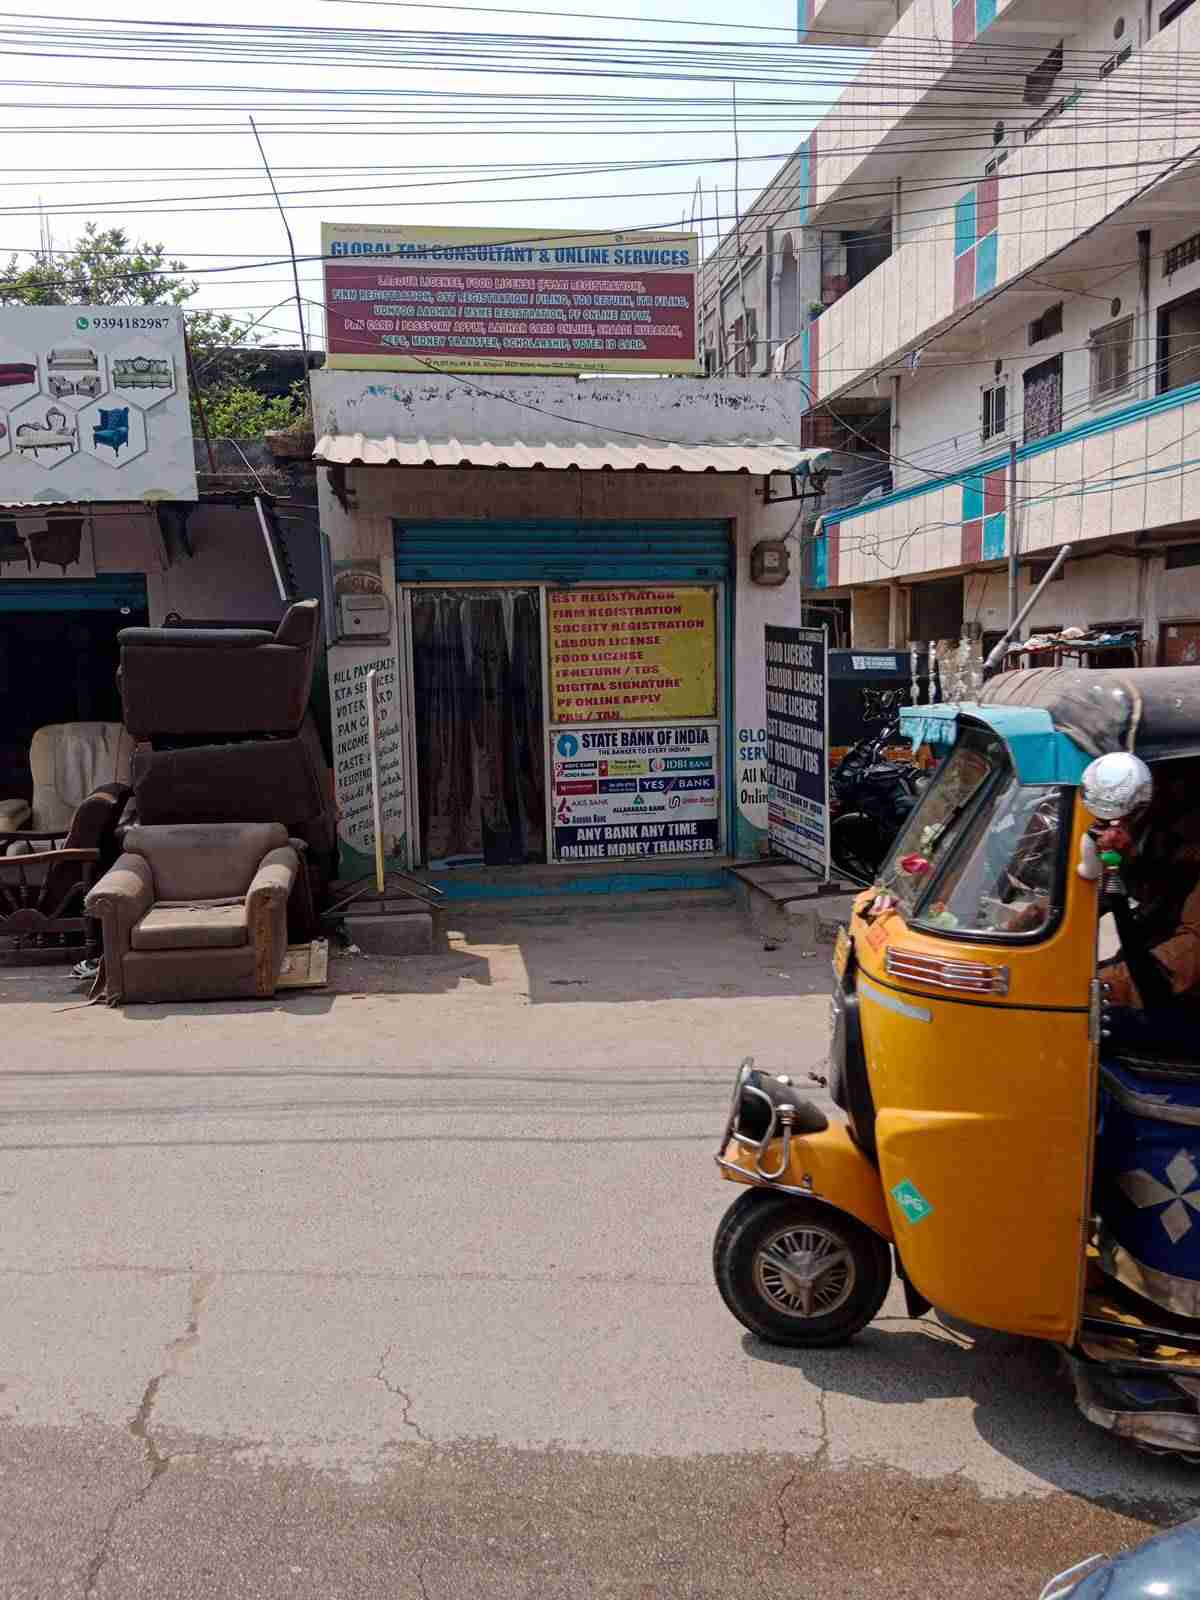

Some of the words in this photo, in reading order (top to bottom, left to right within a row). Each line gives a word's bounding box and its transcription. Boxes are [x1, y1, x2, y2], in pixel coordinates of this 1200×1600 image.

[331, 241, 393, 259] GLOBAL
[431, 245, 534, 263] CONSULTANT
[539, 249, 552, 264] &
[555, 248, 610, 265] ONLINE
[614, 249, 689, 266] SERVICES
[466, 278, 493, 289] FOOD
[495, 278, 536, 290] LICENSE
[458, 292, 529, 304] REGISTRATION
[583, 309, 618, 321] ONLINE
[93, 317, 170, 329] 9394182987
[367, 320, 394, 331] CARD
[529, 323, 555, 334] CARD
[412, 336, 447, 348] MONEY
[573, 339, 604, 350] VOTER
[580, 591, 675, 603] REGISTRATION
[553, 609, 586, 619] FIRM
[588, 605, 682, 618] REGISTRATION
[553, 623, 609, 634] SOCEITY
[611, 619, 705, 632] REGISTRATION
[554, 637, 606, 649] LABOUR
[608, 635, 662, 647] LICENSE
[555, 653, 589, 664] FOOD
[591, 651, 645, 662] LICENSE
[784, 643, 813, 668] LICENSE
[633, 665, 659, 676] TDS
[557, 682, 607, 693] DIGITAL
[608, 678, 683, 691] SIGNATURE
[793, 671, 824, 696] LICENSE
[575, 694, 621, 706] ONLINE
[623, 693, 663, 705] APPLY
[336, 700, 366, 718] VOTER
[788, 694, 818, 722] LICENSE
[336, 720, 358, 737] PAN
[779, 720, 824, 751] REGISTRATION
[581, 733, 619, 749] STATE
[621, 731, 655, 747] BANK
[657, 730, 674, 745] OF
[675, 728, 711, 744] INDIA
[638, 747, 647, 755] TO
[338, 753, 364, 774] CASTE
[666, 759, 688, 770] IDBI
[689, 759, 712, 768] BANK
[742, 768, 757, 784] All
[643, 780, 665, 790] YES
[678, 778, 712, 789] BANK
[576, 828, 603, 841] ANY
[604, 826, 639, 840] BANK
[641, 824, 667, 838] ANY
[667, 823, 698, 836] TIME
[560, 843, 606, 858] ONLINE
[607, 841, 651, 857] MONEY
[651, 838, 714, 855] TRANSFER
